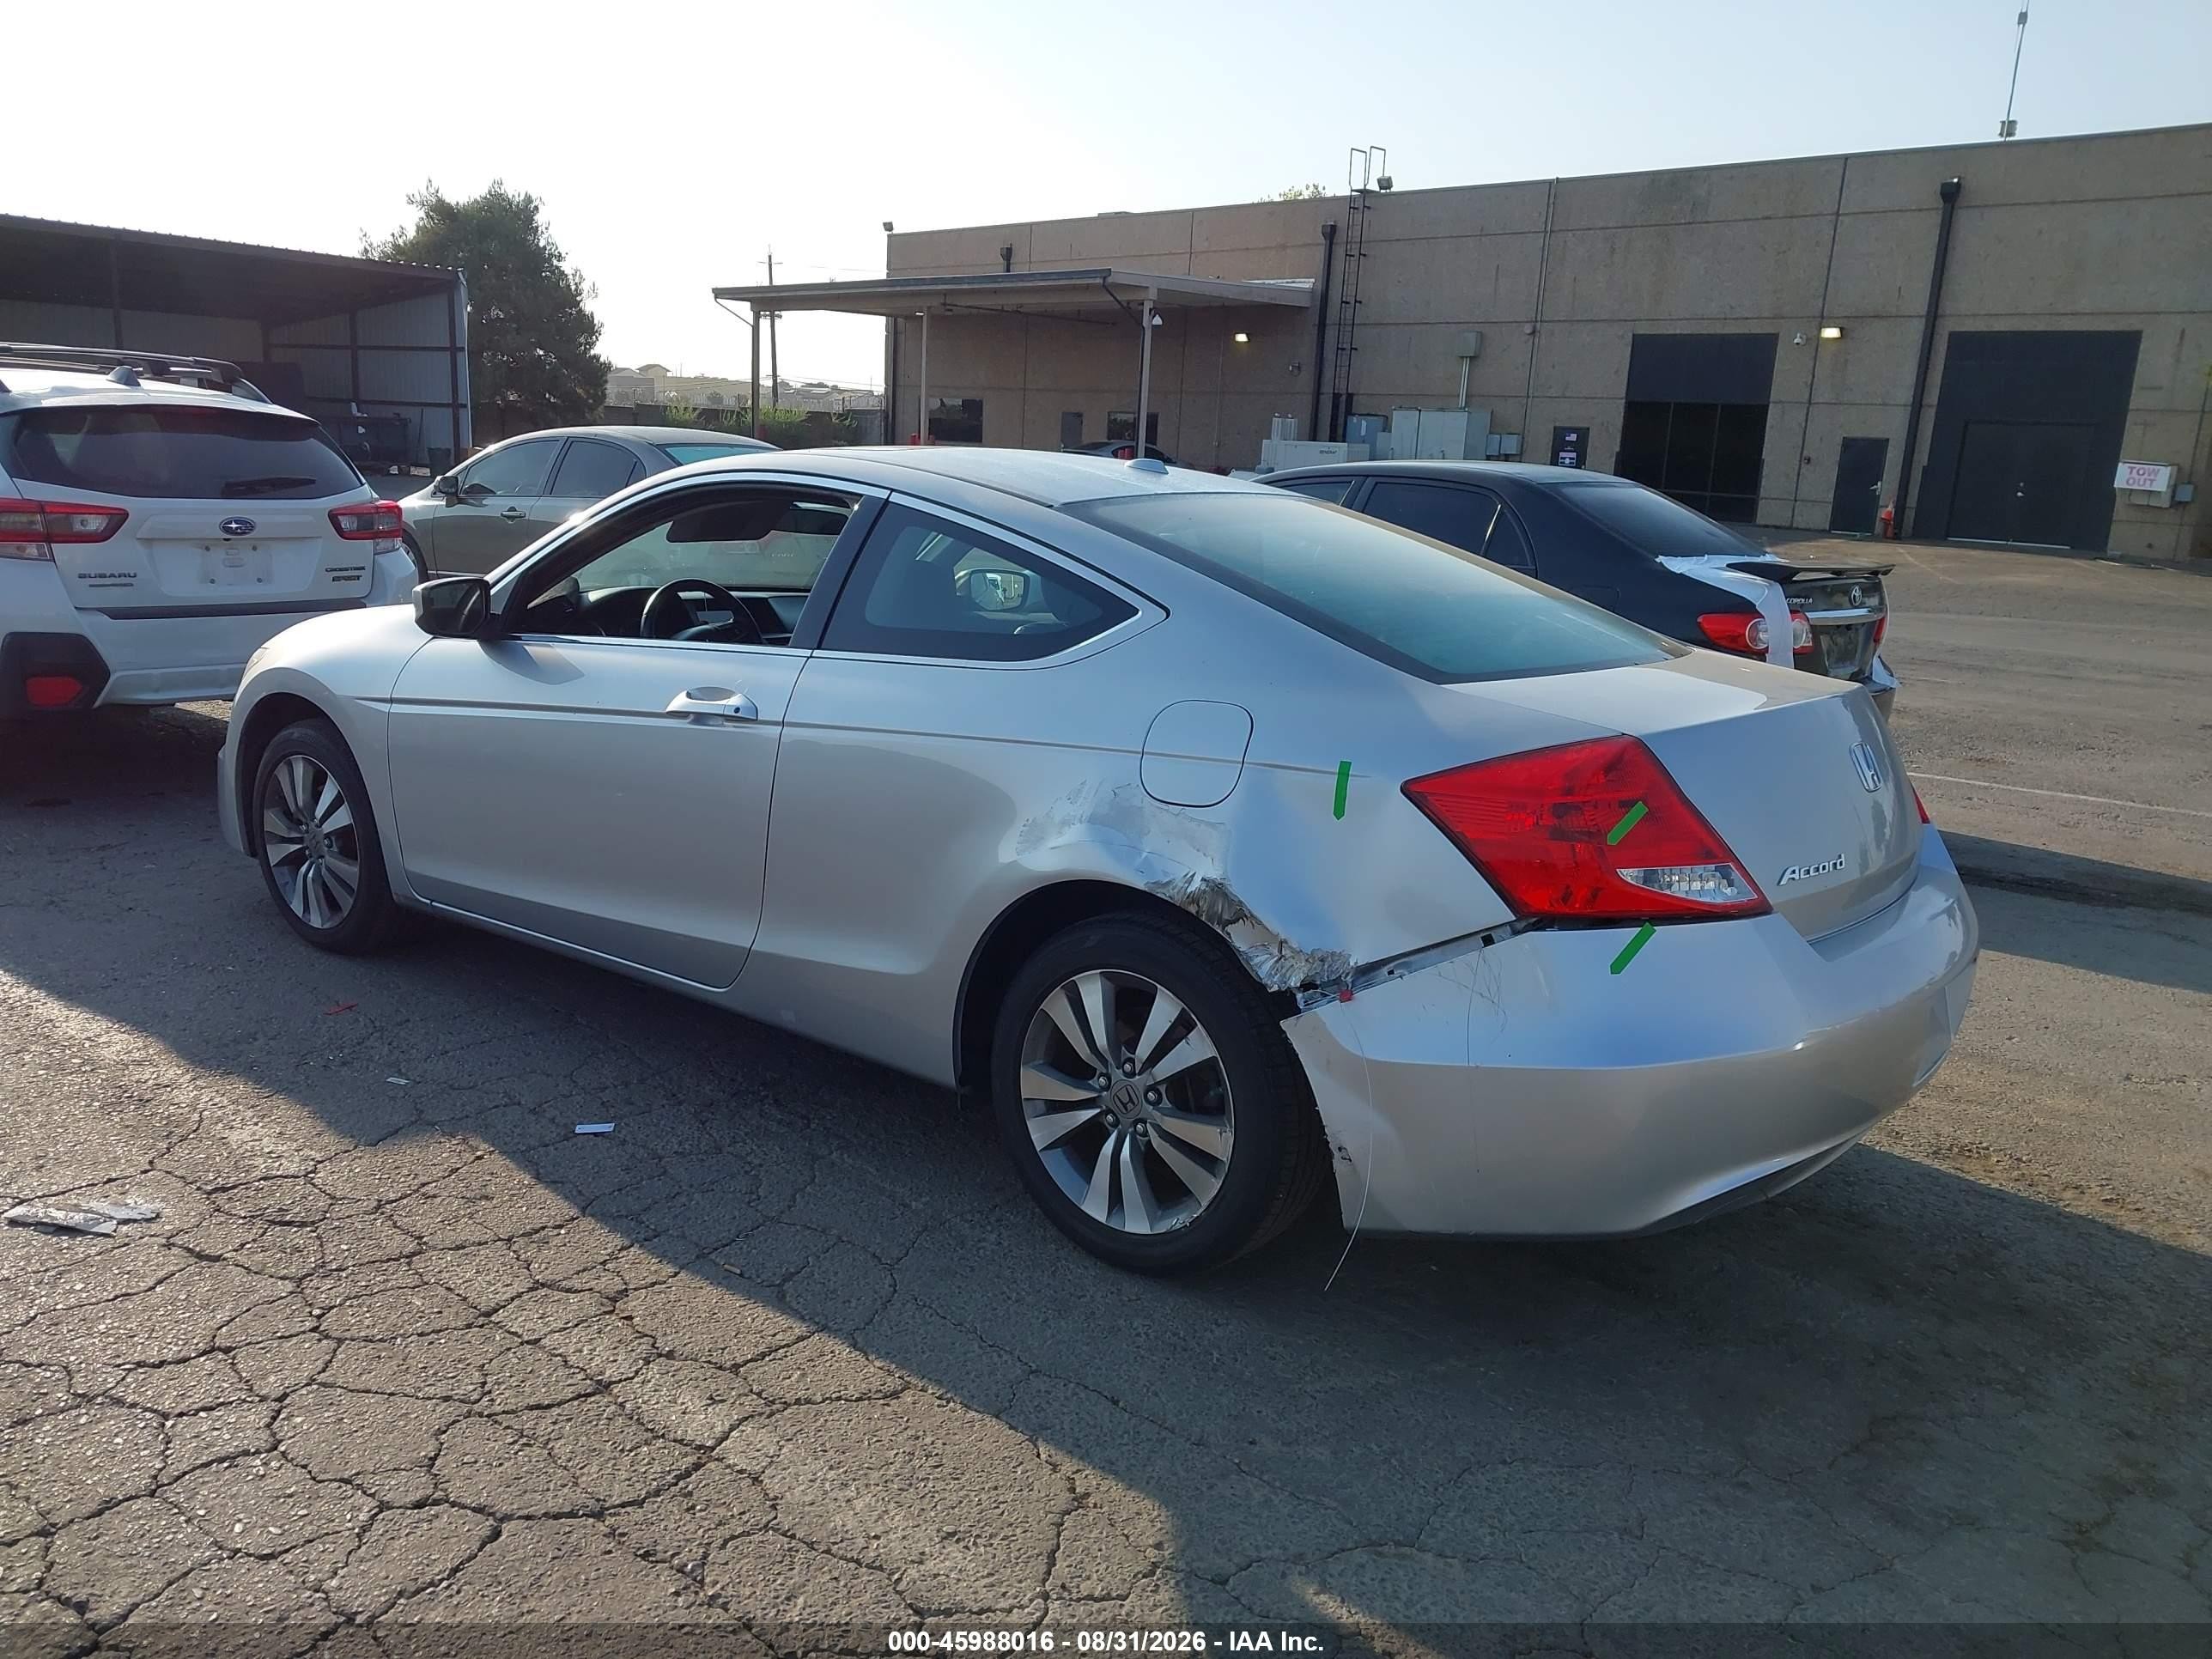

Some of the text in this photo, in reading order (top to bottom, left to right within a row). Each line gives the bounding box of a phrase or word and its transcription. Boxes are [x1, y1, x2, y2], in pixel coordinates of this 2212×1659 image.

[2127, 465, 2160, 478] TOW
[2126, 477, 2157, 488] OUT
[1777, 854, 1845, 886] Accord
